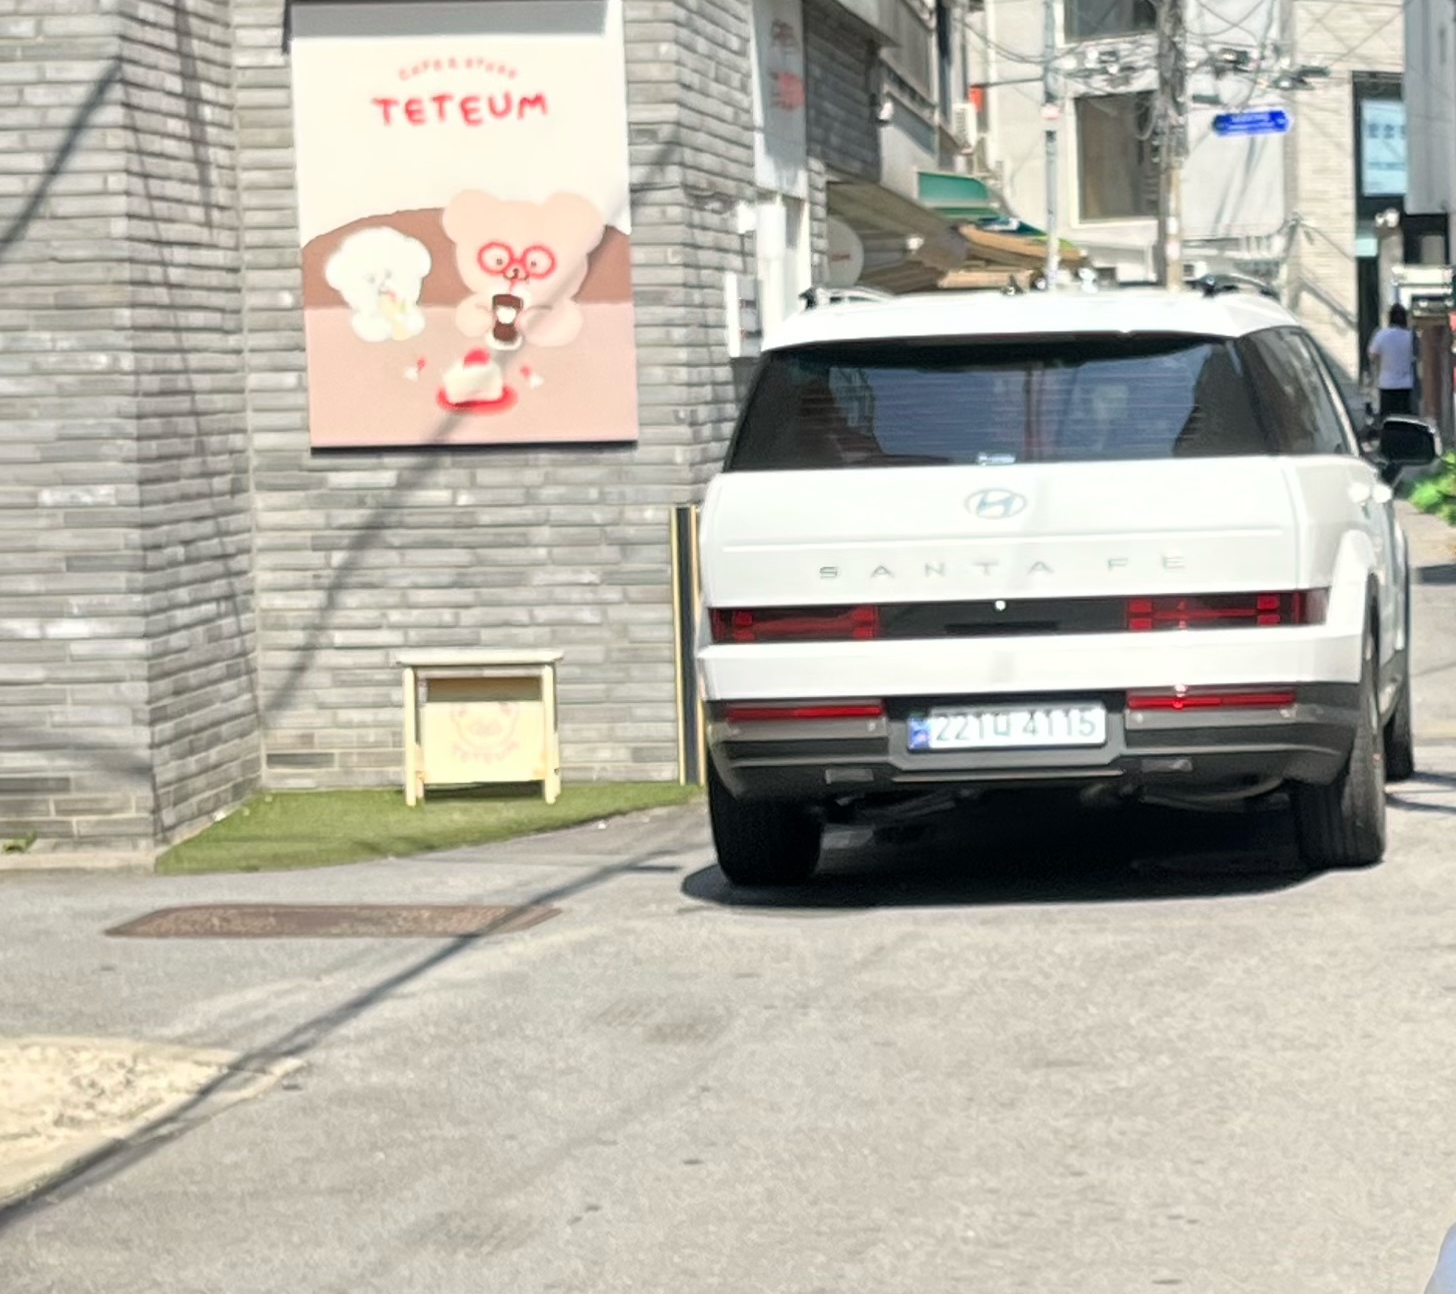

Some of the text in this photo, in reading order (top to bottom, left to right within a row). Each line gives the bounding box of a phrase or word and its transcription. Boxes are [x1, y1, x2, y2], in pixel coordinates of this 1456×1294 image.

[371, 90, 549, 128] TETEUM
[818, 555, 1186, 580] SANTA FE
